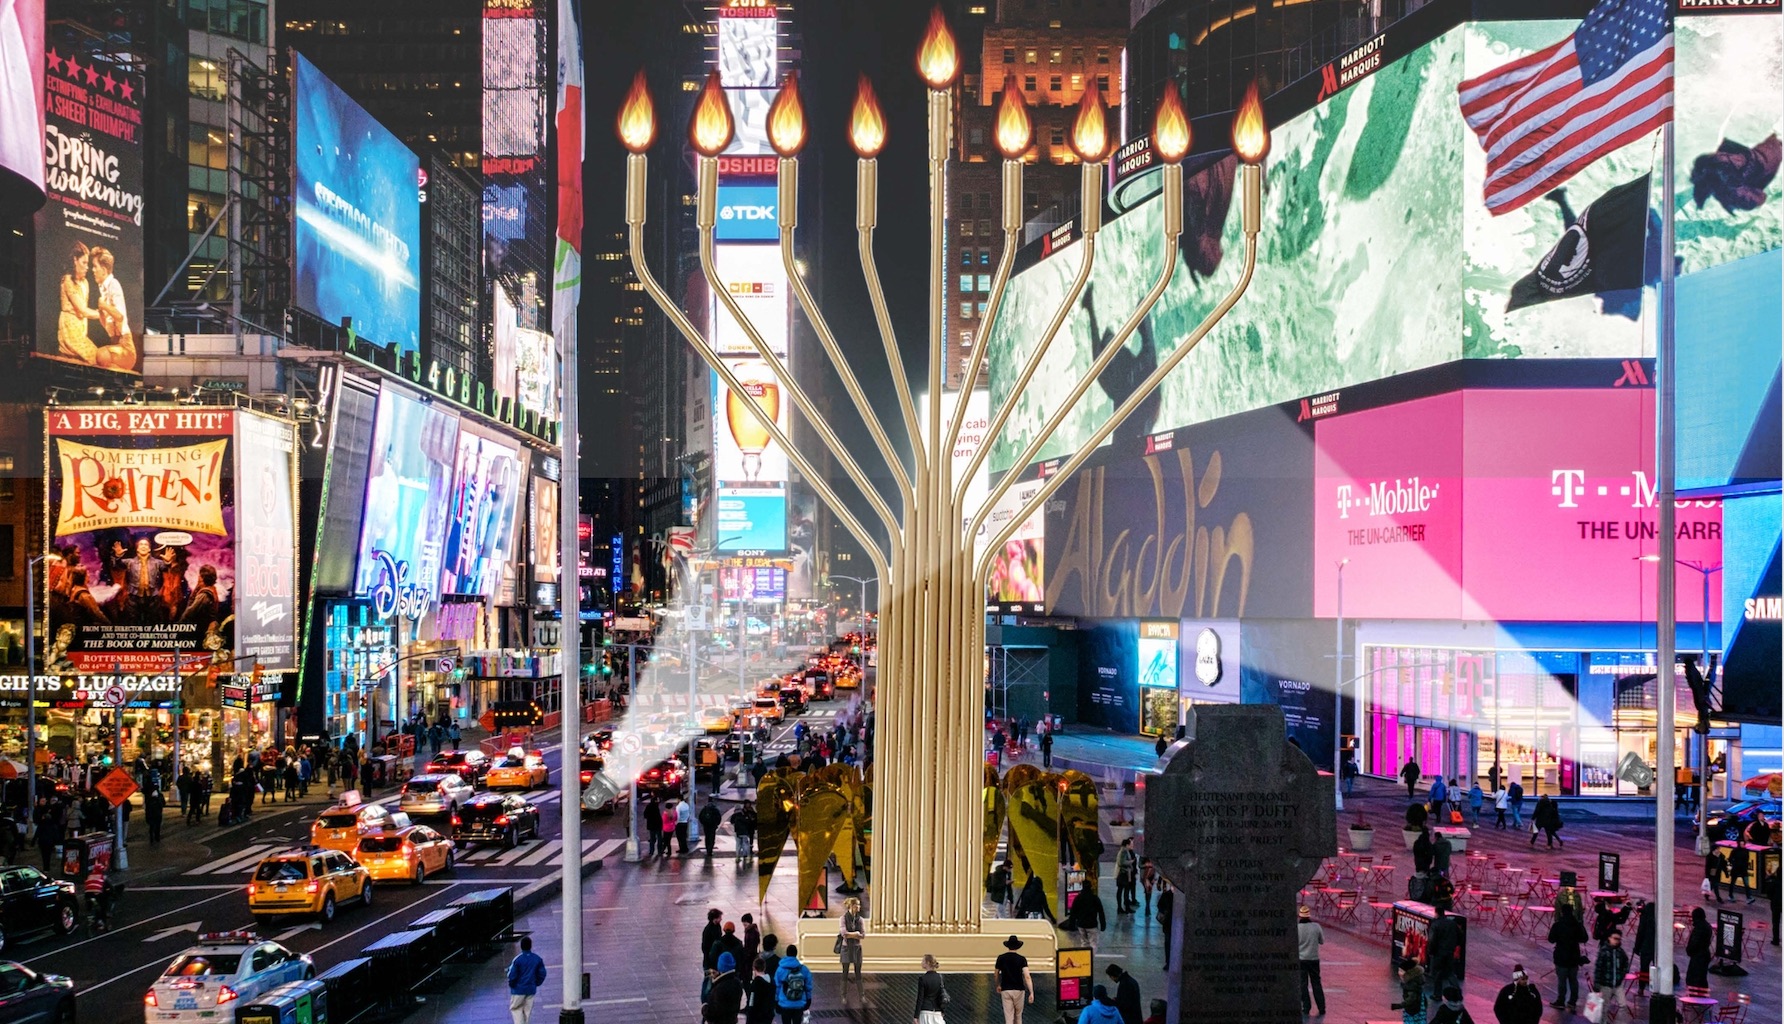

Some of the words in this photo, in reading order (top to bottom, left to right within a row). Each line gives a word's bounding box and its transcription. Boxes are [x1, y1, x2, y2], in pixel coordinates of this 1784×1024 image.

[720, 8, 774, 17] TOSHIBA
[1341, 34, 1386, 69] MARRIOTT
[1341, 54, 1380, 85] MARQUIS
[55, 96, 86, 126] SHEER
[88, 108, 136, 143] TRIUMPH!
[46, 124, 120, 183] SPRING
[732, 206, 775, 220] TDK
[1052, 220, 1074, 239] MARRIOTT
[1312, 392, 1340, 406] MARRIOTT
[1312, 402, 1338, 416] MARQUIS
[78, 412, 122, 430] BIG,
[128, 412, 170, 429] FAT
[82, 448, 202, 465] SOMETHING
[122, 516, 163, 524] HILARIOUS
[1045, 448, 1254, 617] Aladdin
[1348, 529, 1364, 546] THE
[1367, 524, 1426, 544] UN-CARRIER
[1577, 521, 1619, 539] THE
[1625, 521, 1721, 539] UN-ARR
[246, 556, 292, 598] ROCK
[152, 624, 198, 632] ALADDIN
[1278, 680, 1310, 690] VORNADO
[1190, 792, 1243, 801] LIEUTENANT
[1182, 804, 1237, 817] FRANCIS
[1254, 804, 1300, 817] DUFFY
[1198, 836, 1244, 844] CATHOLIC
[1250, 836, 1284, 844] PRIEST
